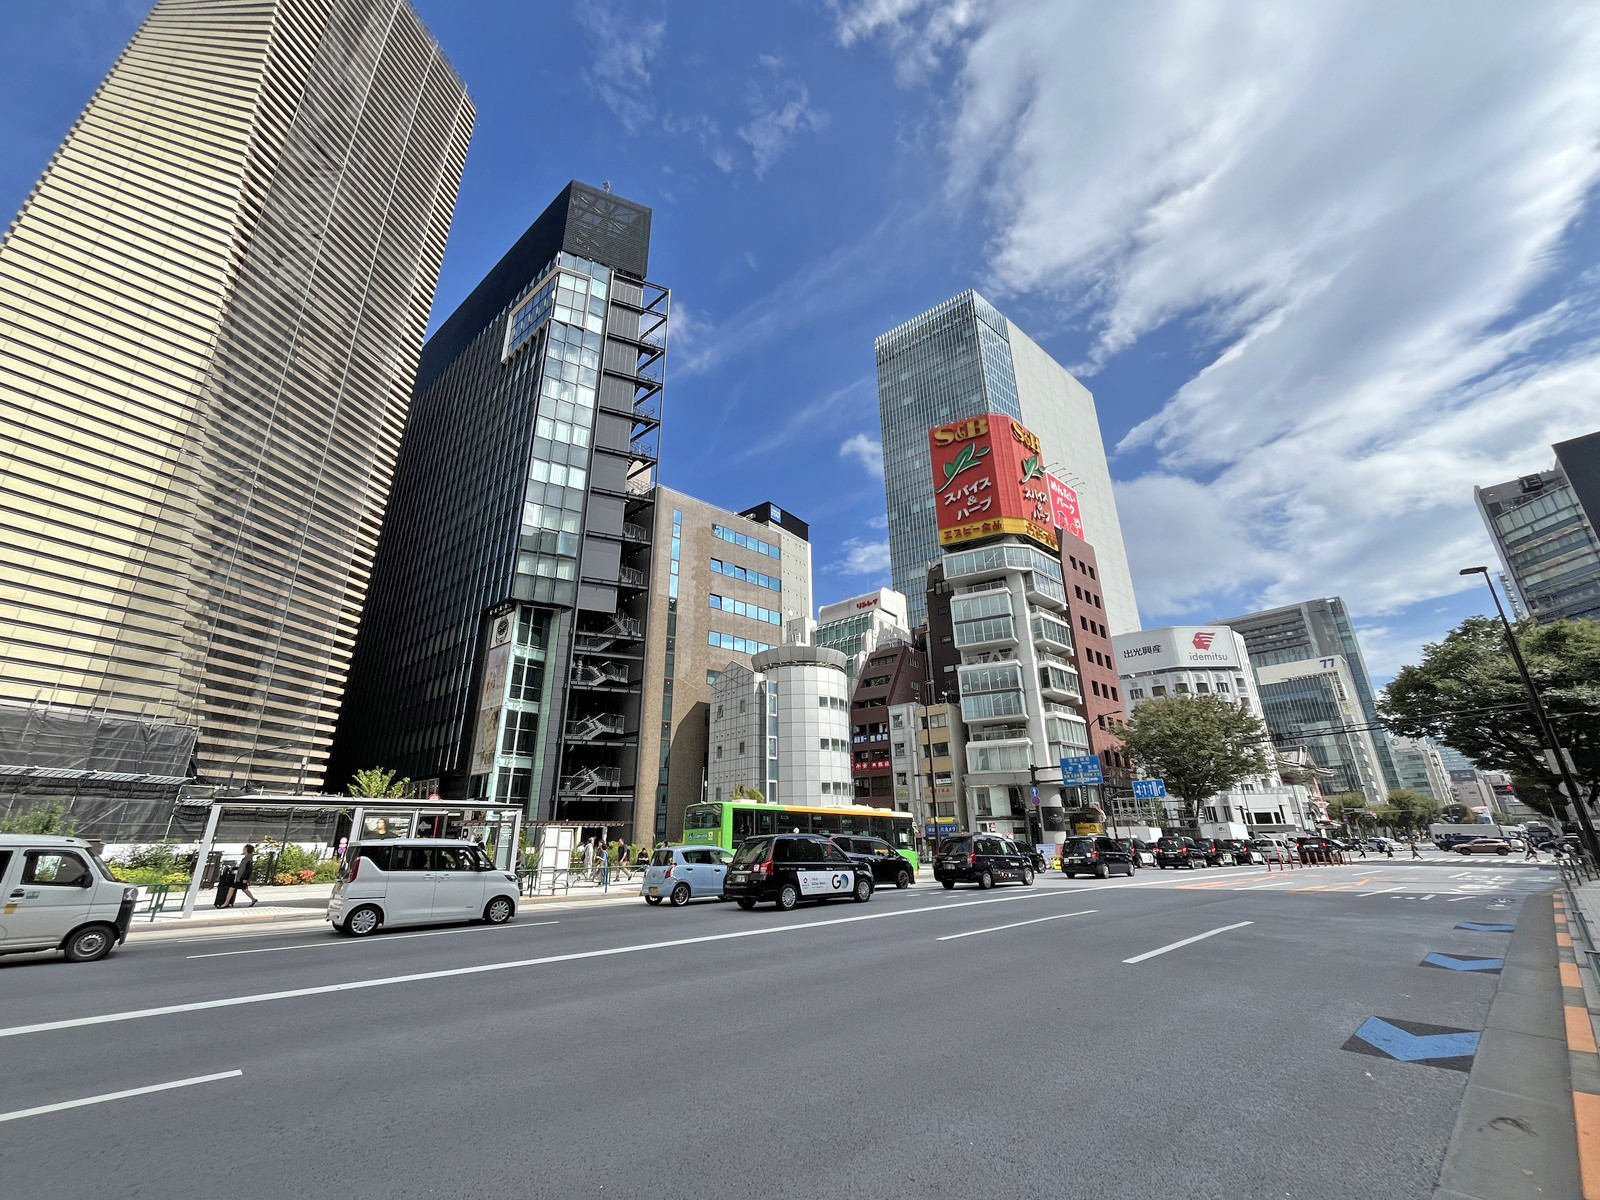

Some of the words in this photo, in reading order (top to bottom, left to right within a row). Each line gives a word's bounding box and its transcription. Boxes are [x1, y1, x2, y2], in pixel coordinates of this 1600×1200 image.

[934, 416, 989, 447] S&B
[1011, 421, 1041, 455] S&B
[944, 476, 992, 506] スパイス
[1024, 488, 1048, 503] スパイス
[1050, 480, 1076, 503] めんたい
[967, 495, 978, 506] &
[1056, 496, 1075, 515] パーク
[944, 520, 1003, 540] エスビー食品
[1123, 644, 1162, 659] 出光興産
[1189, 651, 1228, 661] idemitsu
[1319, 658, 1335, 669] 77
[832, 873, 849, 890] GO
